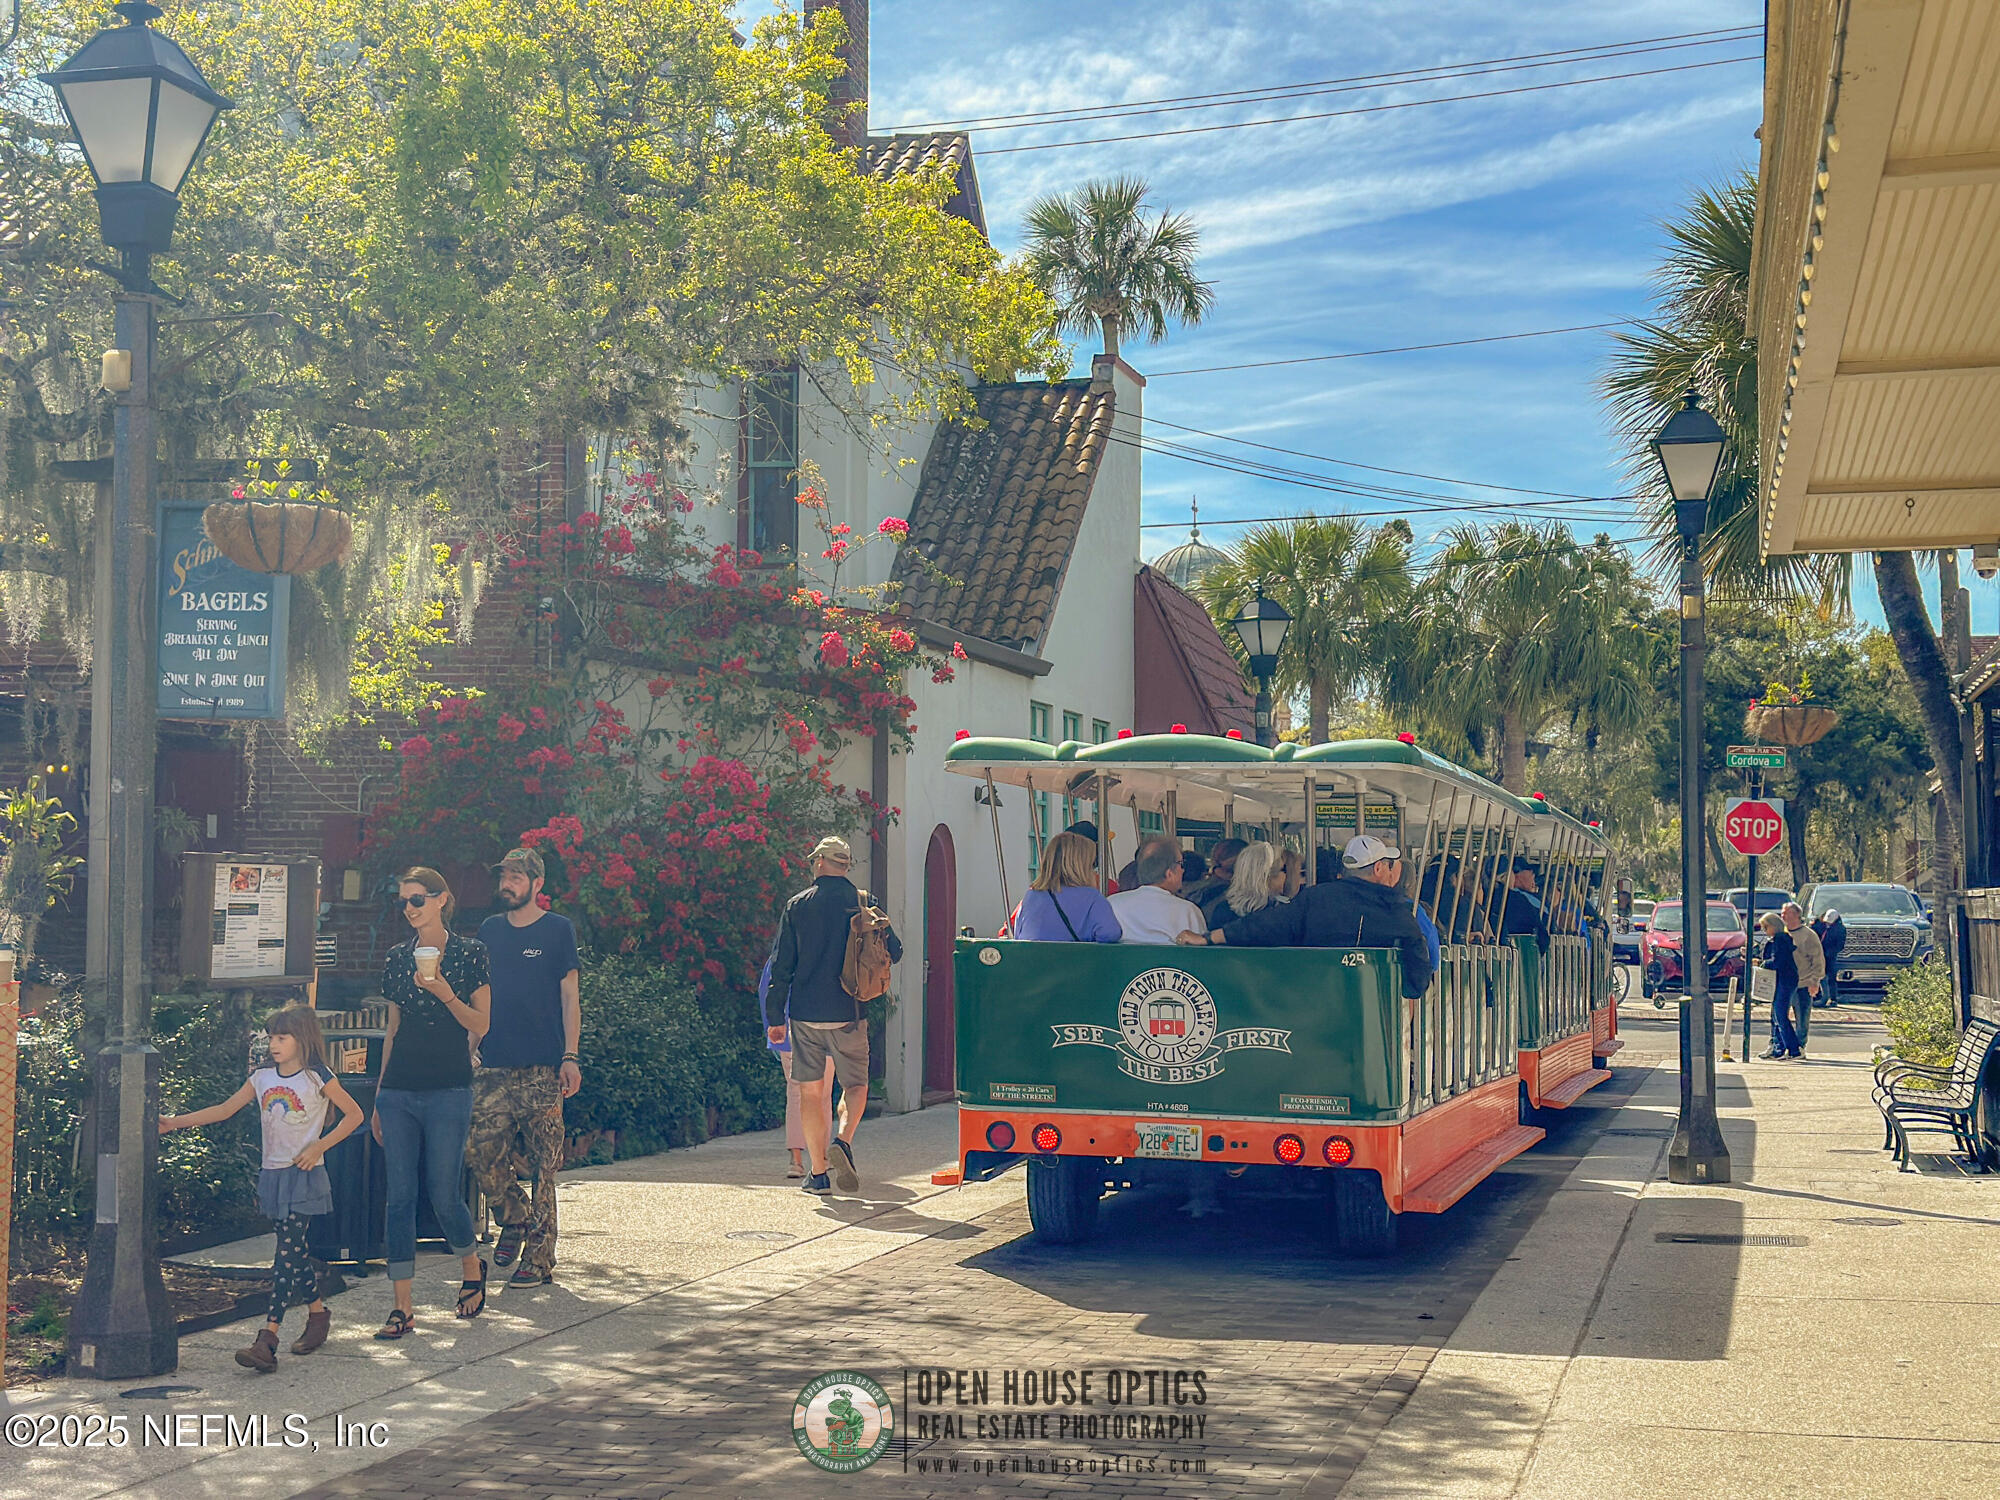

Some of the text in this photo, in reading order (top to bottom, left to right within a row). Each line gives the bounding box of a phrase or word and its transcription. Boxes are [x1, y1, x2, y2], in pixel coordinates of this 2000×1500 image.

[180, 591, 268, 611] BAGELS
[223, 635, 231, 645] &
[226, 698, 244, 706] 1989
[1731, 754, 1770, 766] Cordova
[1728, 817, 1779, 839] STOP
[1122, 972, 1214, 1029] OLD TOWN TROLLEY
[1063, 1026, 1284, 1082] SEE THE BEST FIRST
[1135, 1035, 1203, 1063] TOURS
[1001, 1085, 1021, 1093] Trolley
[1290, 1097, 1339, 1105] ECO-FRIENDLY
[1315, 1104, 1346, 1112] TROLLEY
[1139, 1133, 1199, 1152] Y28 FEJ
